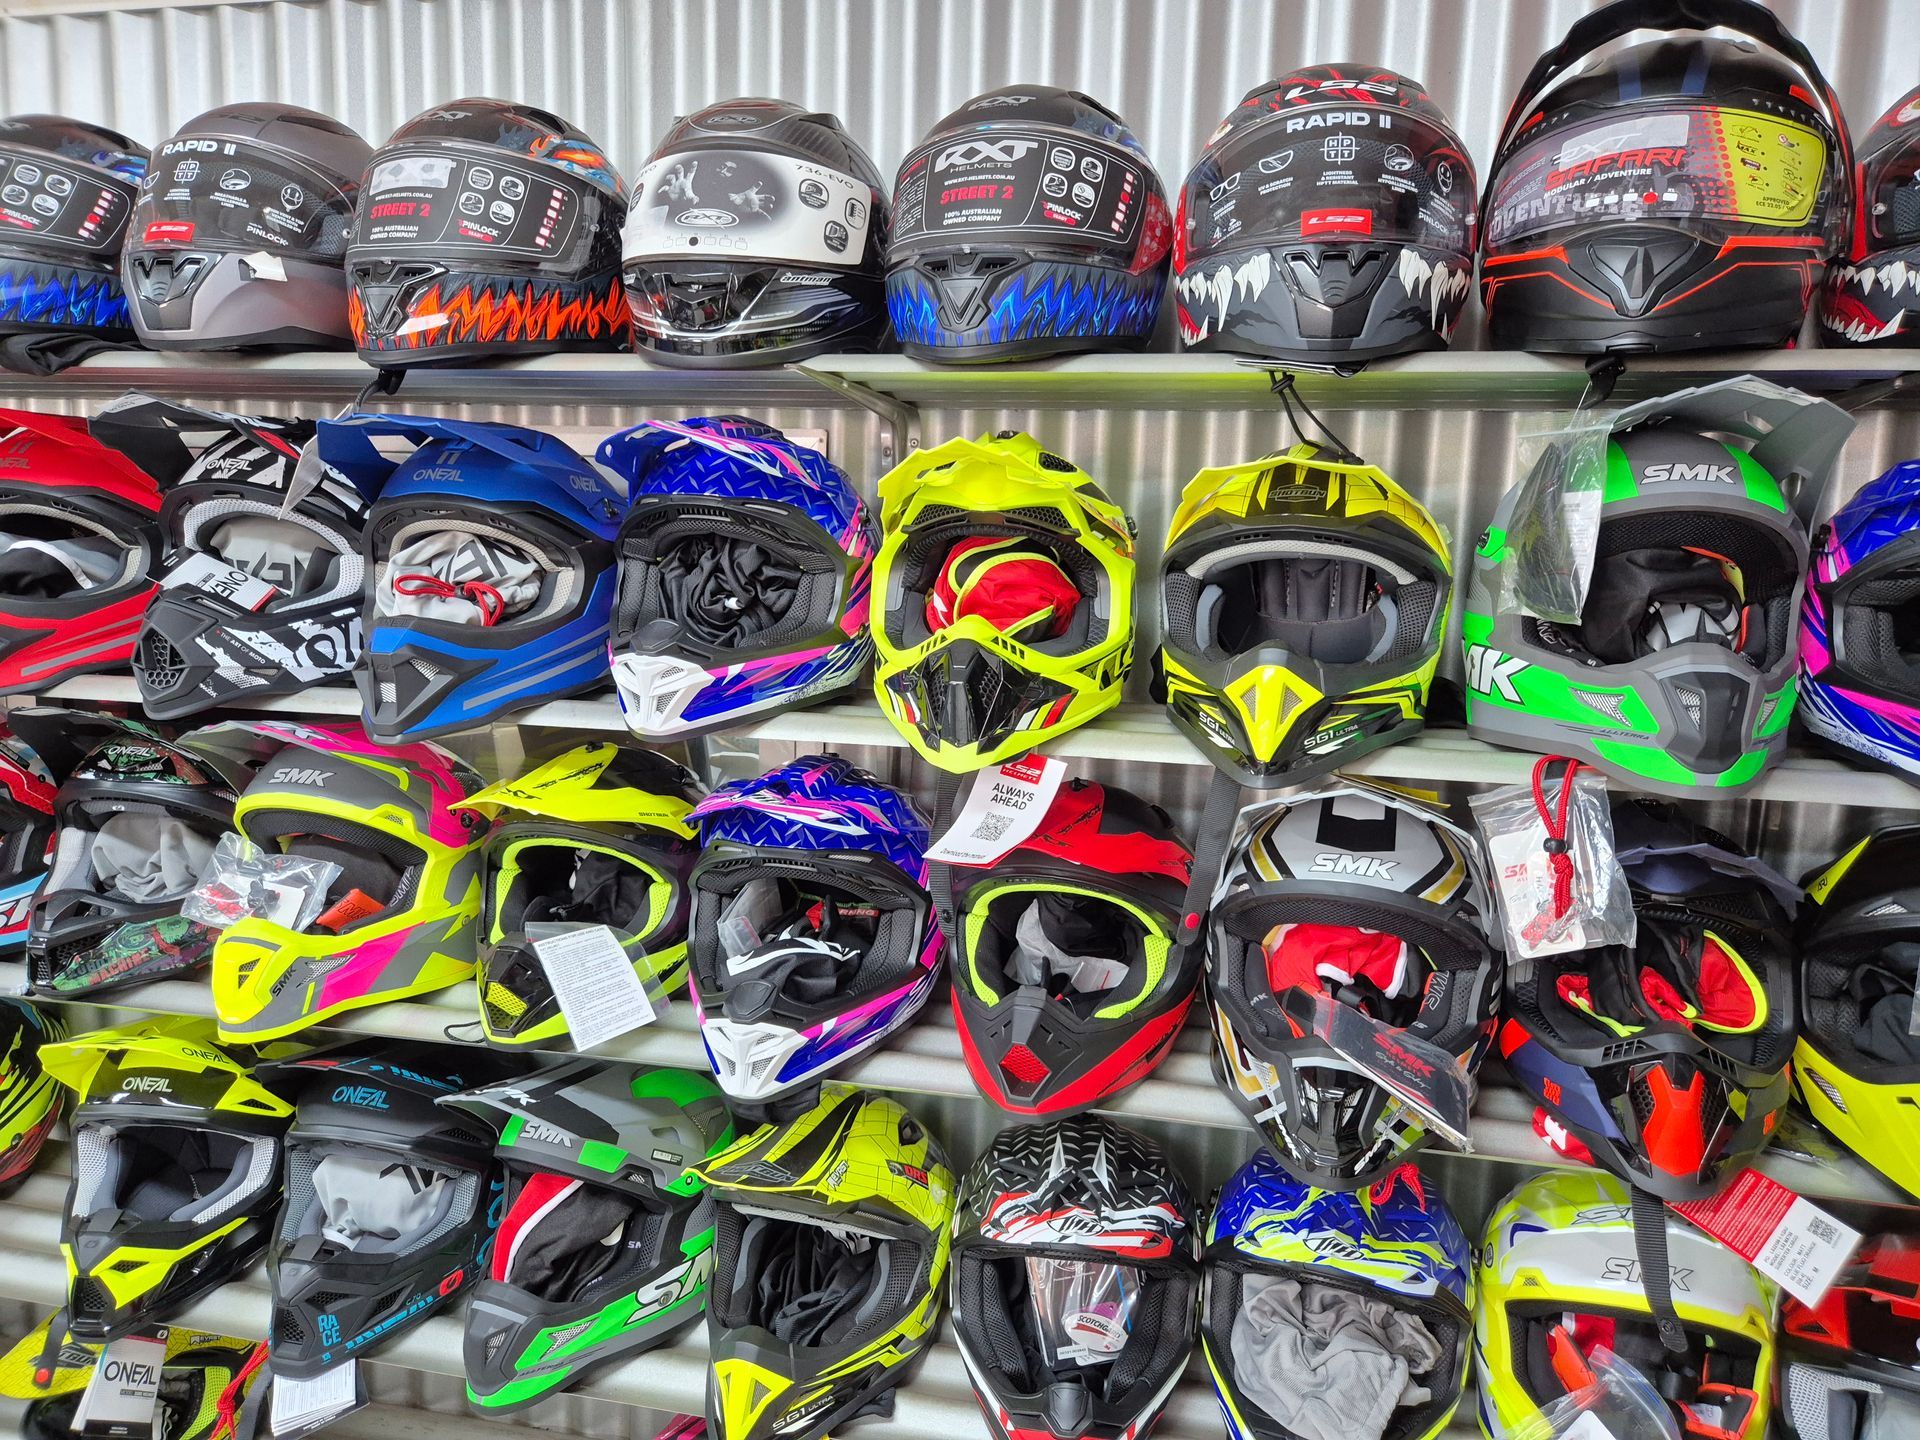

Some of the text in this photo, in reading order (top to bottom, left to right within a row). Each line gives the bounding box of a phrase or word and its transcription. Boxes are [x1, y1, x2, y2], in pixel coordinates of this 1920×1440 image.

[1285, 80, 1397, 100] LS2
[1287, 112, 1391, 134] RAPID II
[162, 140, 236, 156] RAPID II
[934, 140, 1038, 173] RXT
[950, 162, 1013, 174] HELMETS
[1543, 149, 1686, 191] SAFARI
[1544, 177, 1585, 198] MODULAR
[1594, 168, 1652, 182] ADVENTURE
[940, 184, 1014, 205] STREET 2
[1762, 196, 1790, 205] APPROVED
[370, 202, 432, 219] STREET 2
[961, 208, 1002, 216] AUSTRALIAN
[967, 215, 1001, 223] COMPANY
[1308, 215, 1365, 224] LS2
[1419, 212, 1448, 232] PINLOCK
[247, 225, 288, 246] PINLOCK
[1640, 463, 1737, 486] SMK
[220, 632, 231, 642] THE
[230, 638, 242, 649] ART
[249, 651, 266, 665] MOTO
[1199, 711, 1220, 732] SG1
[1303, 724, 1359, 749] SG1 ULTRA
[268, 768, 336, 787] SMK
[1004, 764, 1041, 776] LS2
[990, 794, 1027, 810] AHEAD
[992, 782, 1035, 802] ALWAYS
[1309, 852, 1401, 881] SMK
[272, 966, 297, 996] SMK
[1373, 1032, 1436, 1078] SMK
[773, 1407, 806, 1432] SG1
